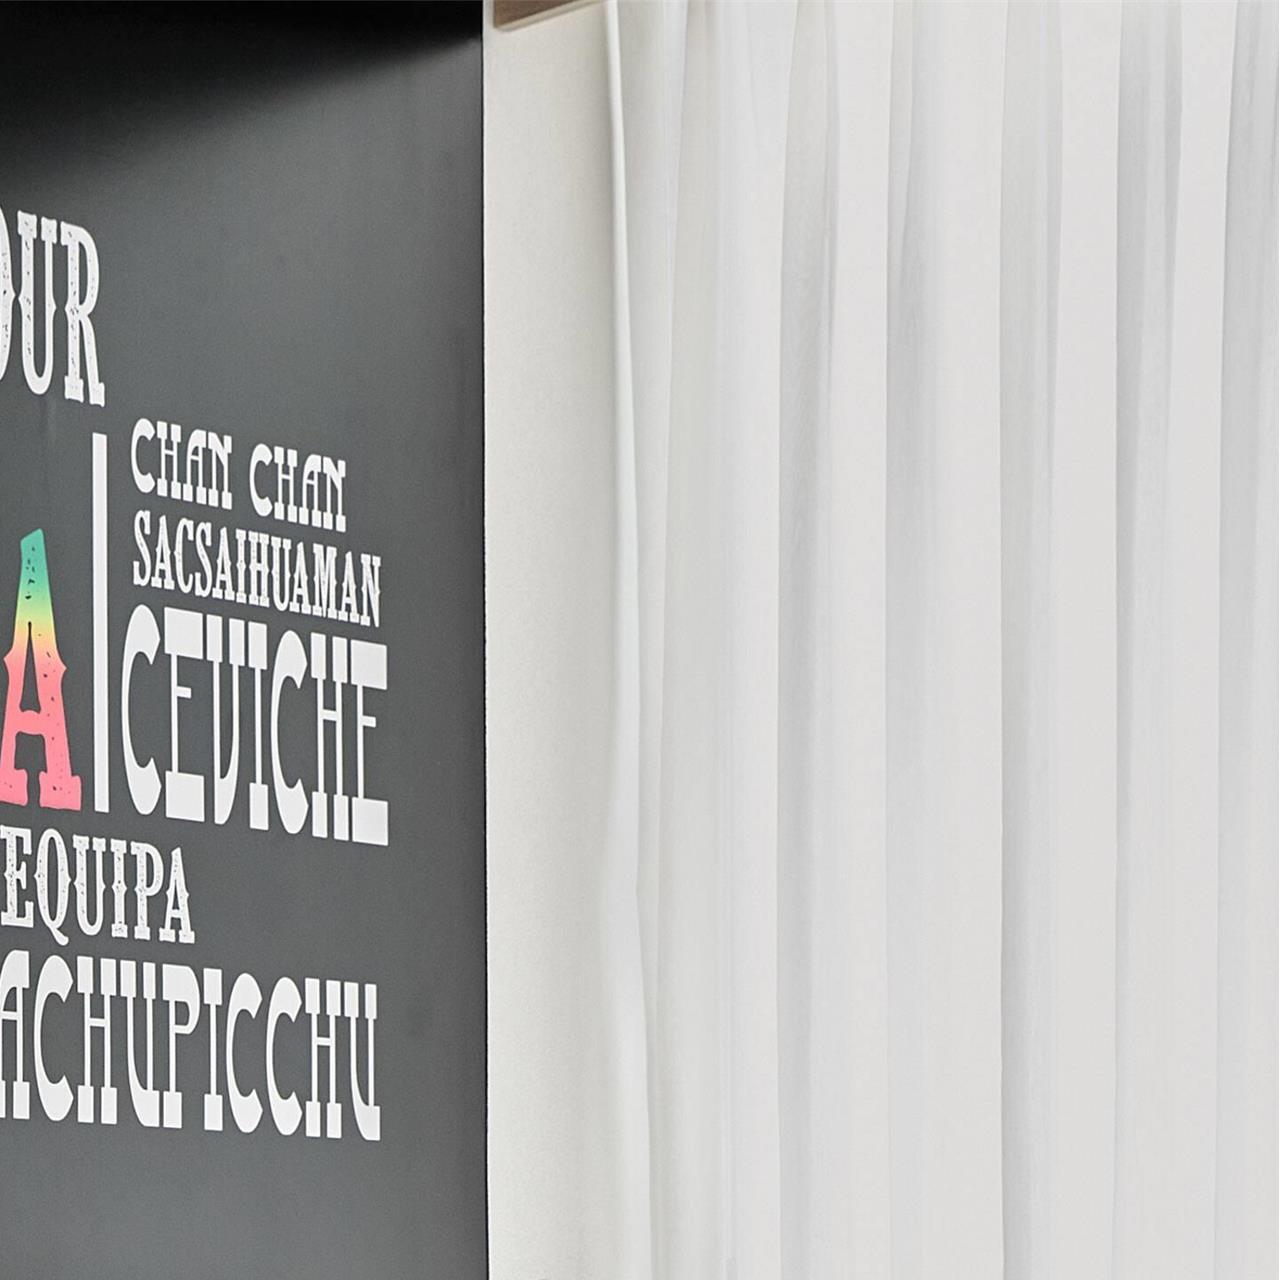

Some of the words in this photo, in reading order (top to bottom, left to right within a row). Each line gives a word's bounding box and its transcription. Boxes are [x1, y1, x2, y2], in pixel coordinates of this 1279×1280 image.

[131, 417, 233, 511] CHAN
[248, 442, 347, 533] CHAN
[132, 509, 382, 628] SACSAIHUAMAN
